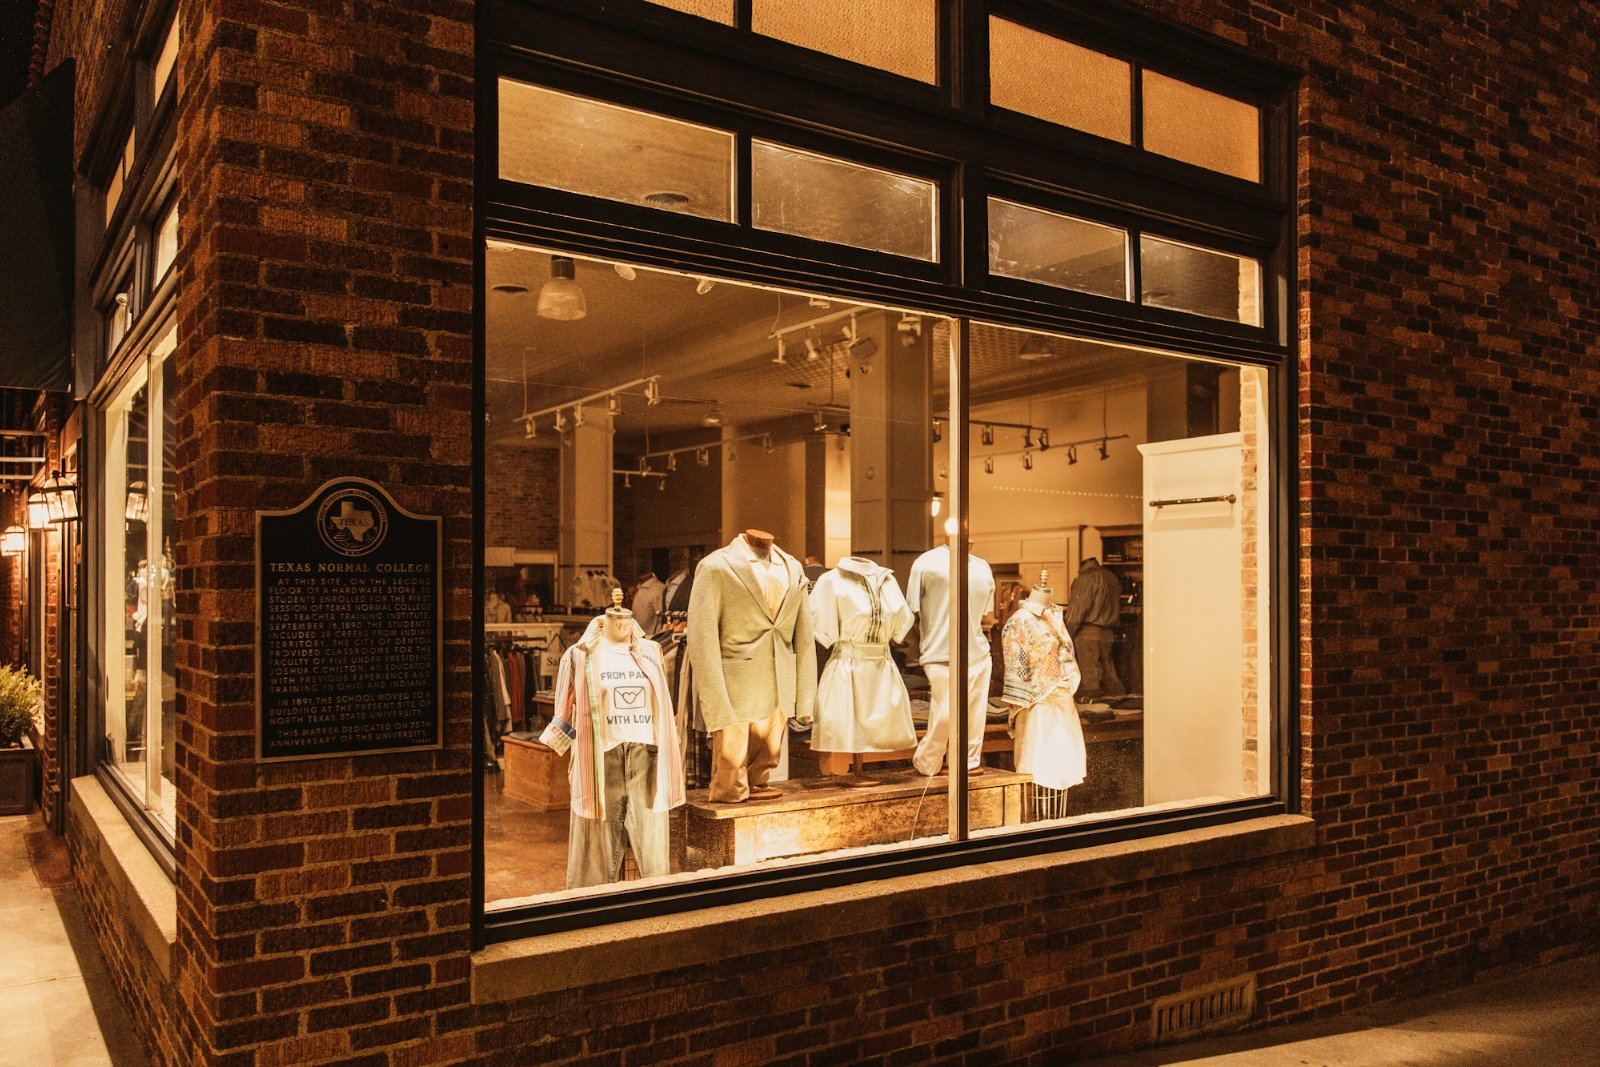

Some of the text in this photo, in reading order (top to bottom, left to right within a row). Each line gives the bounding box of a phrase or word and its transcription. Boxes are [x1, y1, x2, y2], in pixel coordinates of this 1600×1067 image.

[270, 563, 431, 572] TEXAS NORMAL COLLEGE
[269, 631, 316, 639] INCLUDED
[335, 630, 368, 638] CREEKS
[269, 649, 320, 657] PROVIDED
[325, 647, 389, 656] CLASSROOMS
[269, 658, 309, 666] FACULTY
[270, 667, 309, 675] JOSHUA
[600, 672, 627, 680] FROM
[300, 675, 348, 683] PREVIOUS
[353, 672, 409, 681] EXPERIENCE
[270, 685, 318, 693] TRAINING
[336, 695, 375, 703] SCHOOL
[378, 693, 409, 701] MOVED
[269, 707, 317, 716] BUILDING
[355, 703, 393, 711] PRESENT
[398, 701, 415, 709] SITE
[269, 717, 303, 725] NORTH
[308, 715, 336, 723] TEXAS
[340, 713, 366, 721] STATE
[607, 715, 630, 725] WITH
[277, 729, 298, 737] THIS
[303, 727, 339, 736] MARKER
[342, 724, 391, 733] DEDICATED
[270, 736, 336, 747] ANNIVERSARY
